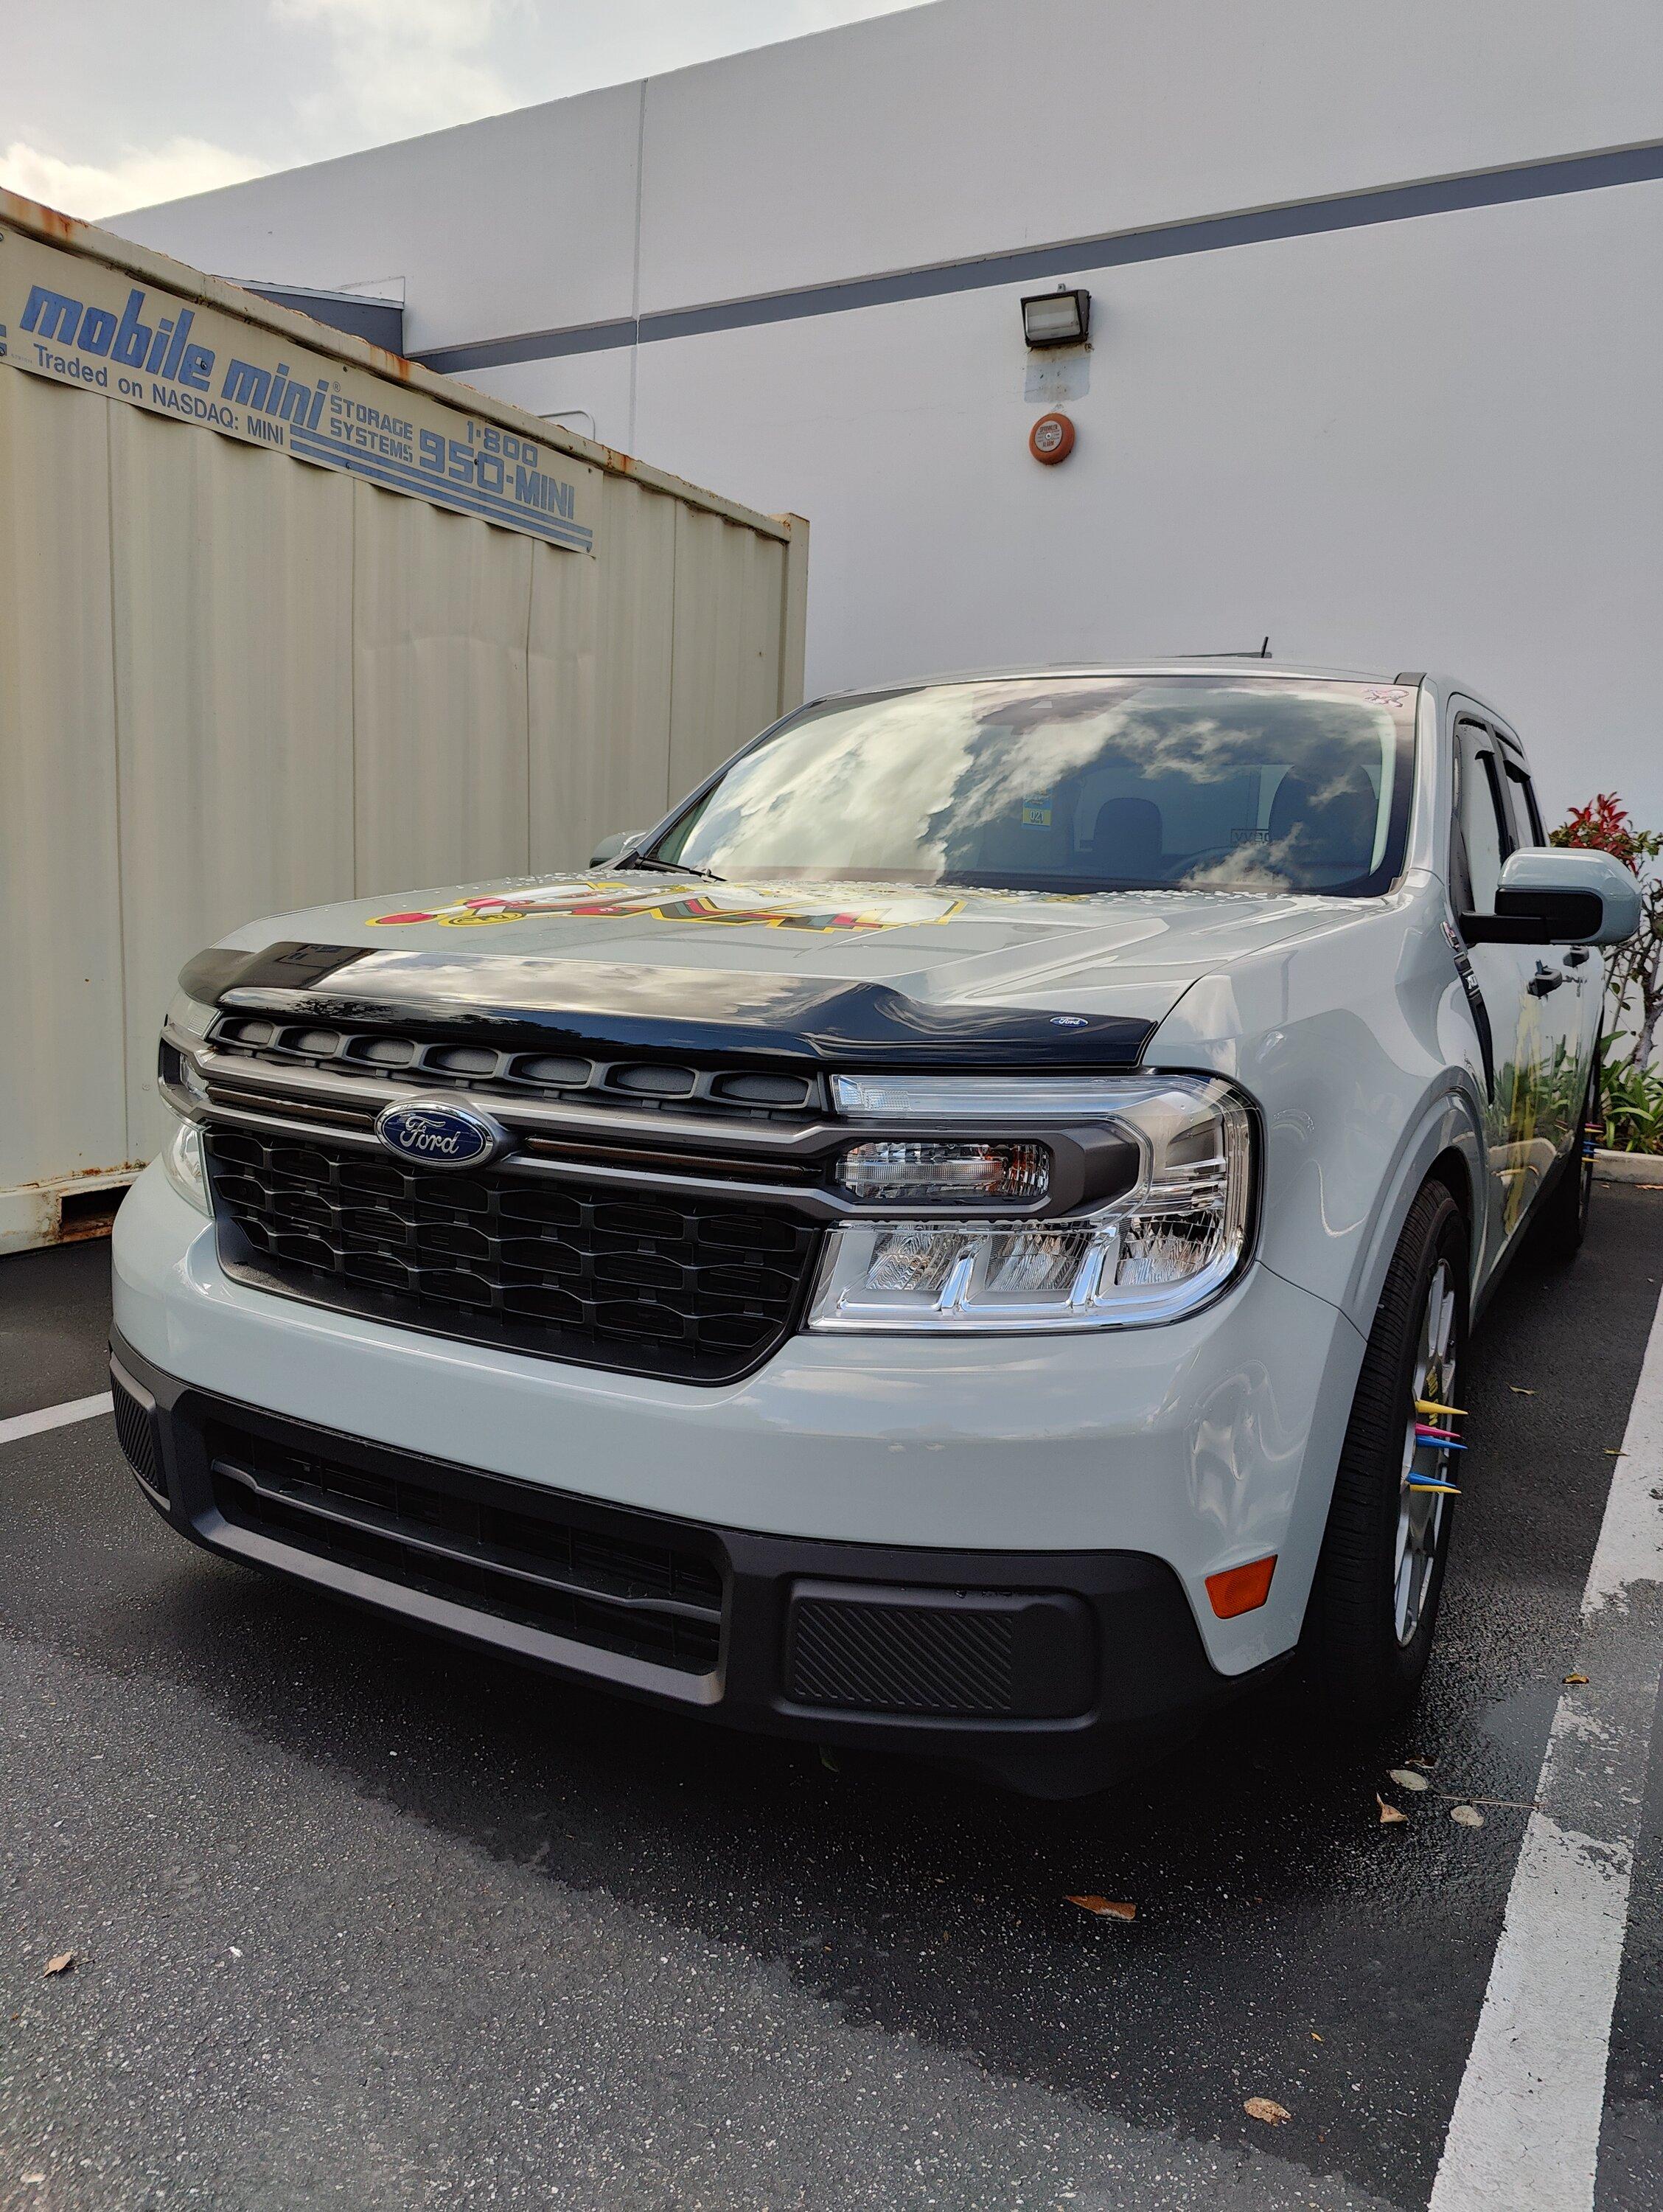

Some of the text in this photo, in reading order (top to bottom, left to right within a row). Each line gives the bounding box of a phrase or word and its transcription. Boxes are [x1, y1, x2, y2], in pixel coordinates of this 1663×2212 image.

[20, 285, 215, 392] mobile
[34, 344, 284, 445] Traded on NASDAQ: MINI
[330, 394, 413, 441] STORAGE
[330, 417, 413, 463] SYSTEMS
[467, 420, 538, 468] 1-800
[419, 428, 574, 520] 950-MINI
[400, 1116, 461, 1154] Ford
